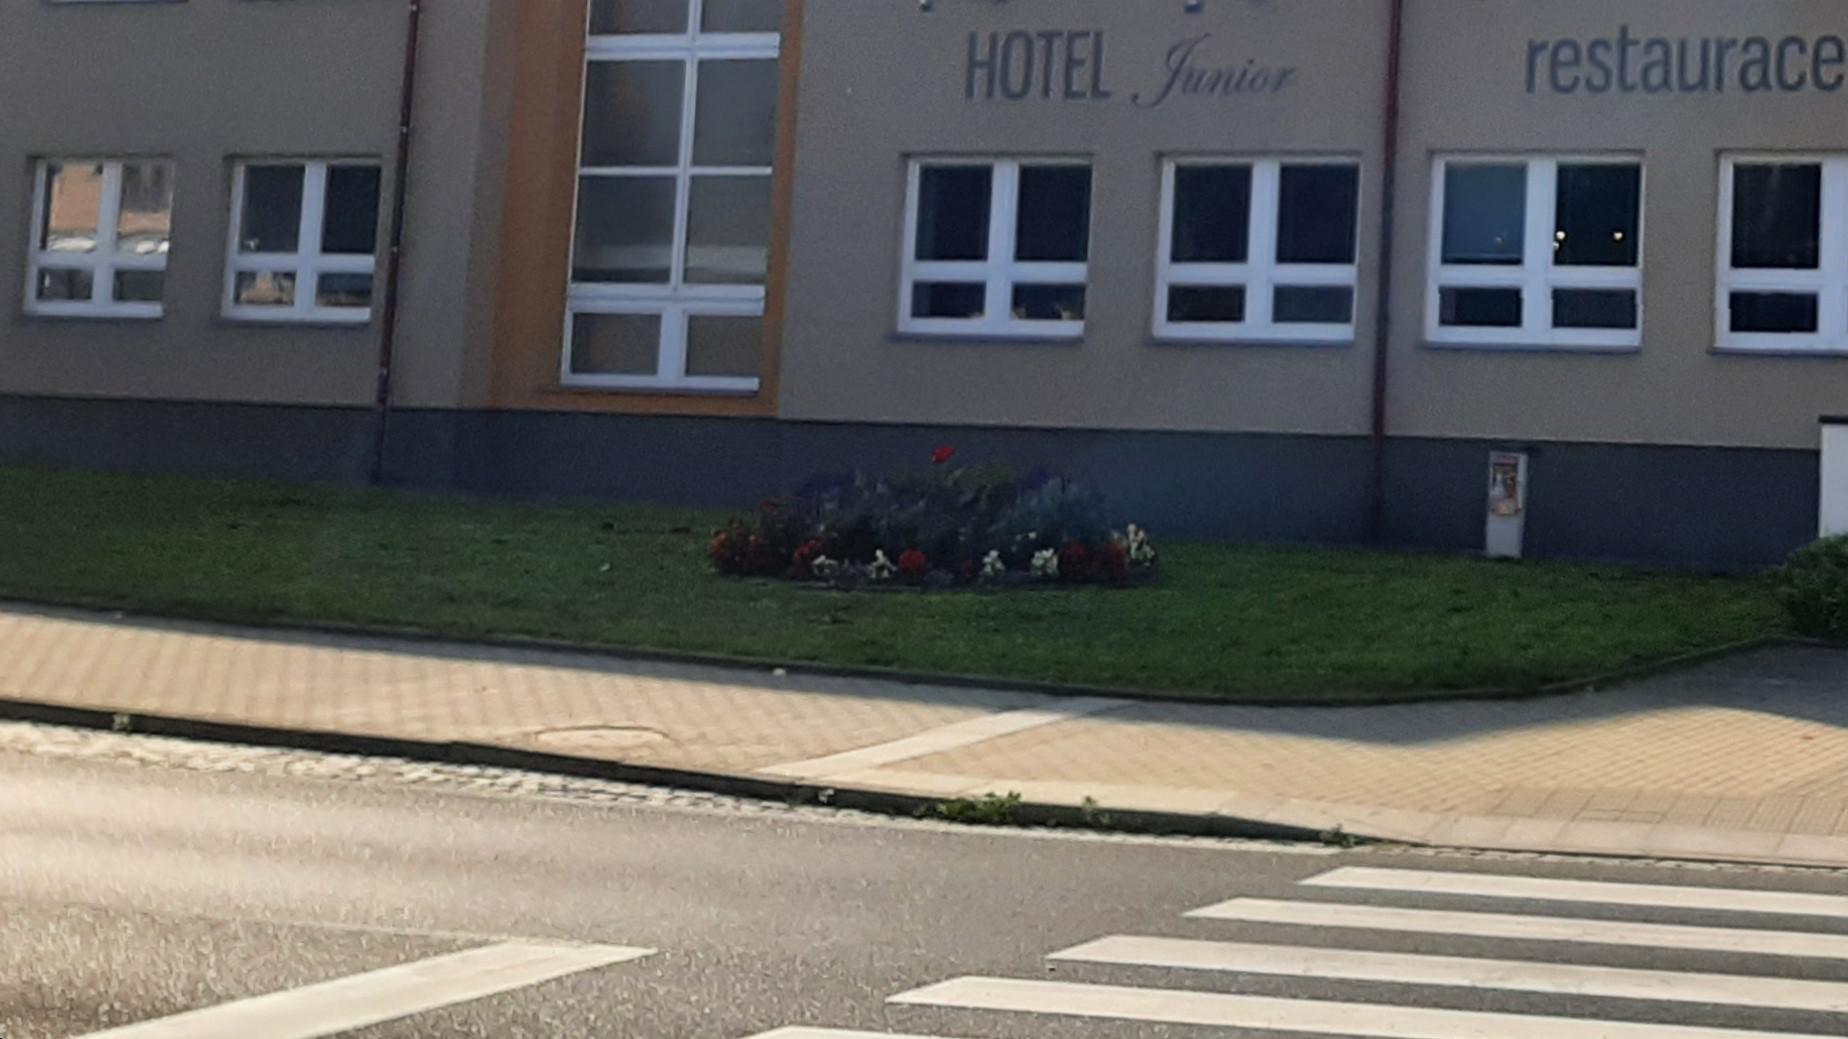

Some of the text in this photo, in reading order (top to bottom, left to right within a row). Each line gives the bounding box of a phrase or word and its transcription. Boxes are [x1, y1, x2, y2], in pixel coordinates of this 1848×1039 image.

[965, 29, 1296, 108] HOTEL Junior
[1525, 25, 1846, 94] restaurace
